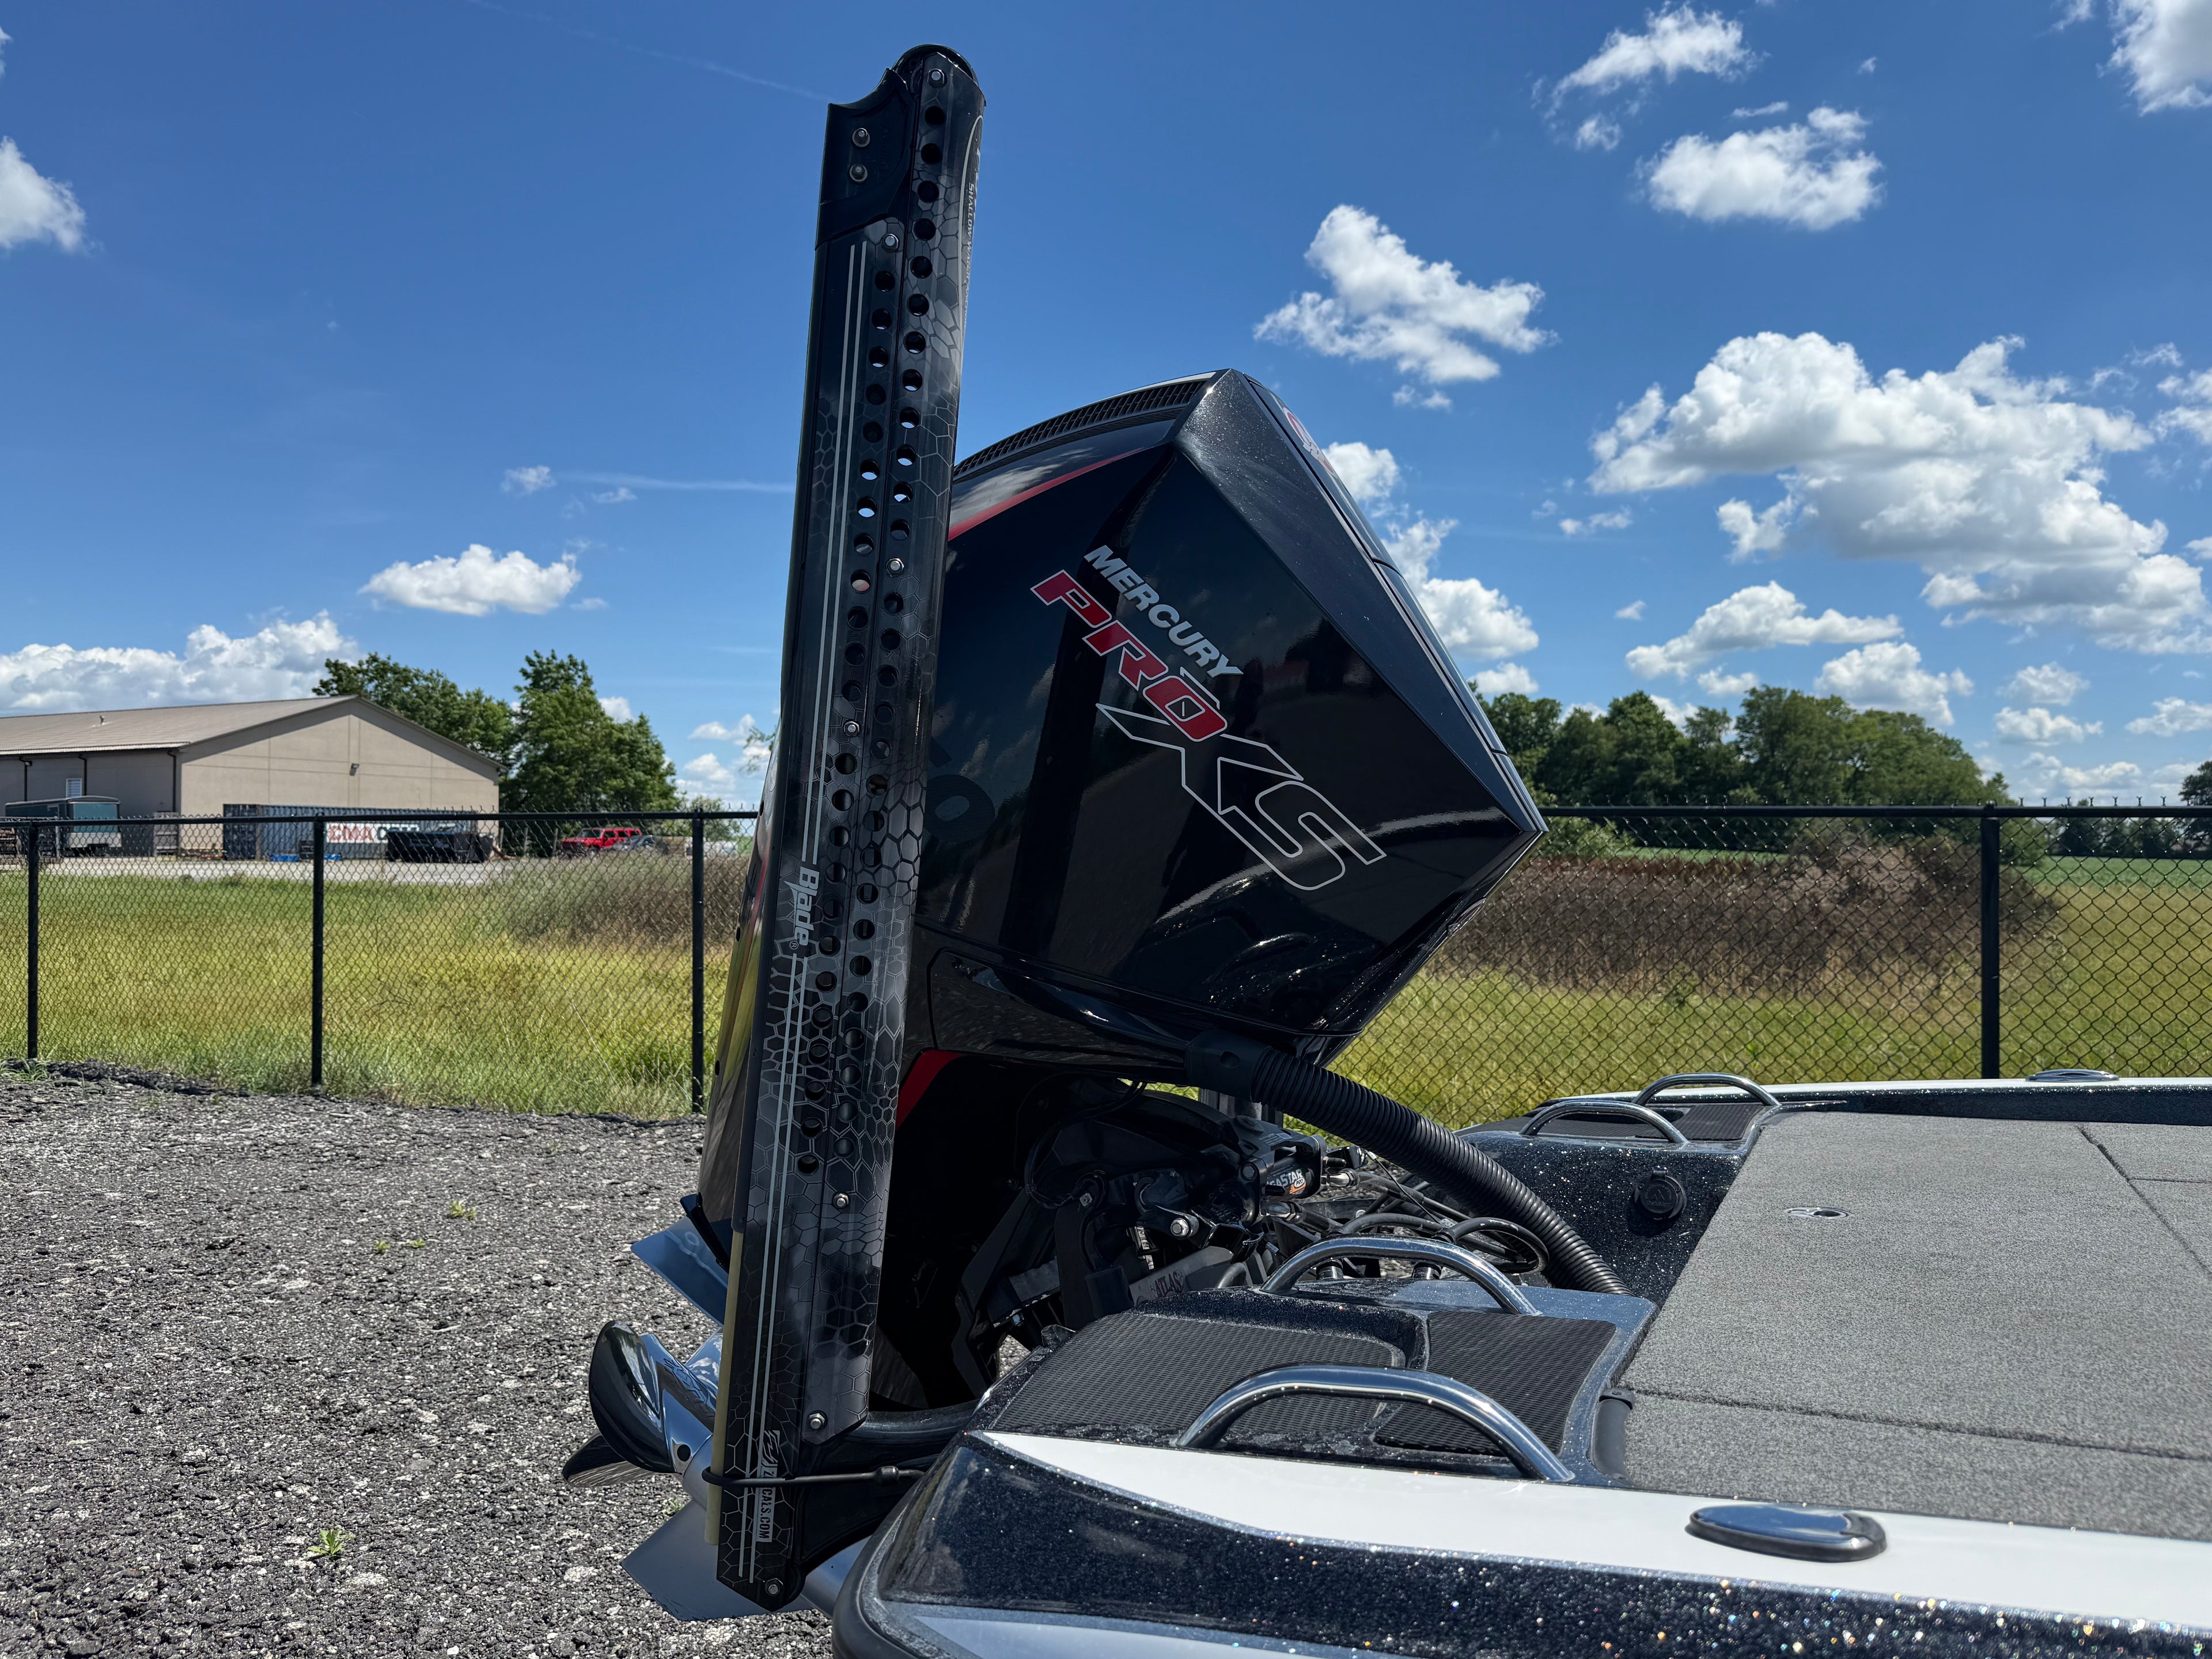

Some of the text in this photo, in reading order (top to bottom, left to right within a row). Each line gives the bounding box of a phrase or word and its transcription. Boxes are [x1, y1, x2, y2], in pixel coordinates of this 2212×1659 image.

[1030, 569, 1228, 742] PRO
[1084, 544, 1243, 679] MERCURY
[1096, 666, 1387, 891] XS
[1267, 1169, 1303, 1187] EASTAR
[1154, 1269, 1183, 1298] ATLAS
[759, 1470, 774, 1539] ZCALS.COM
